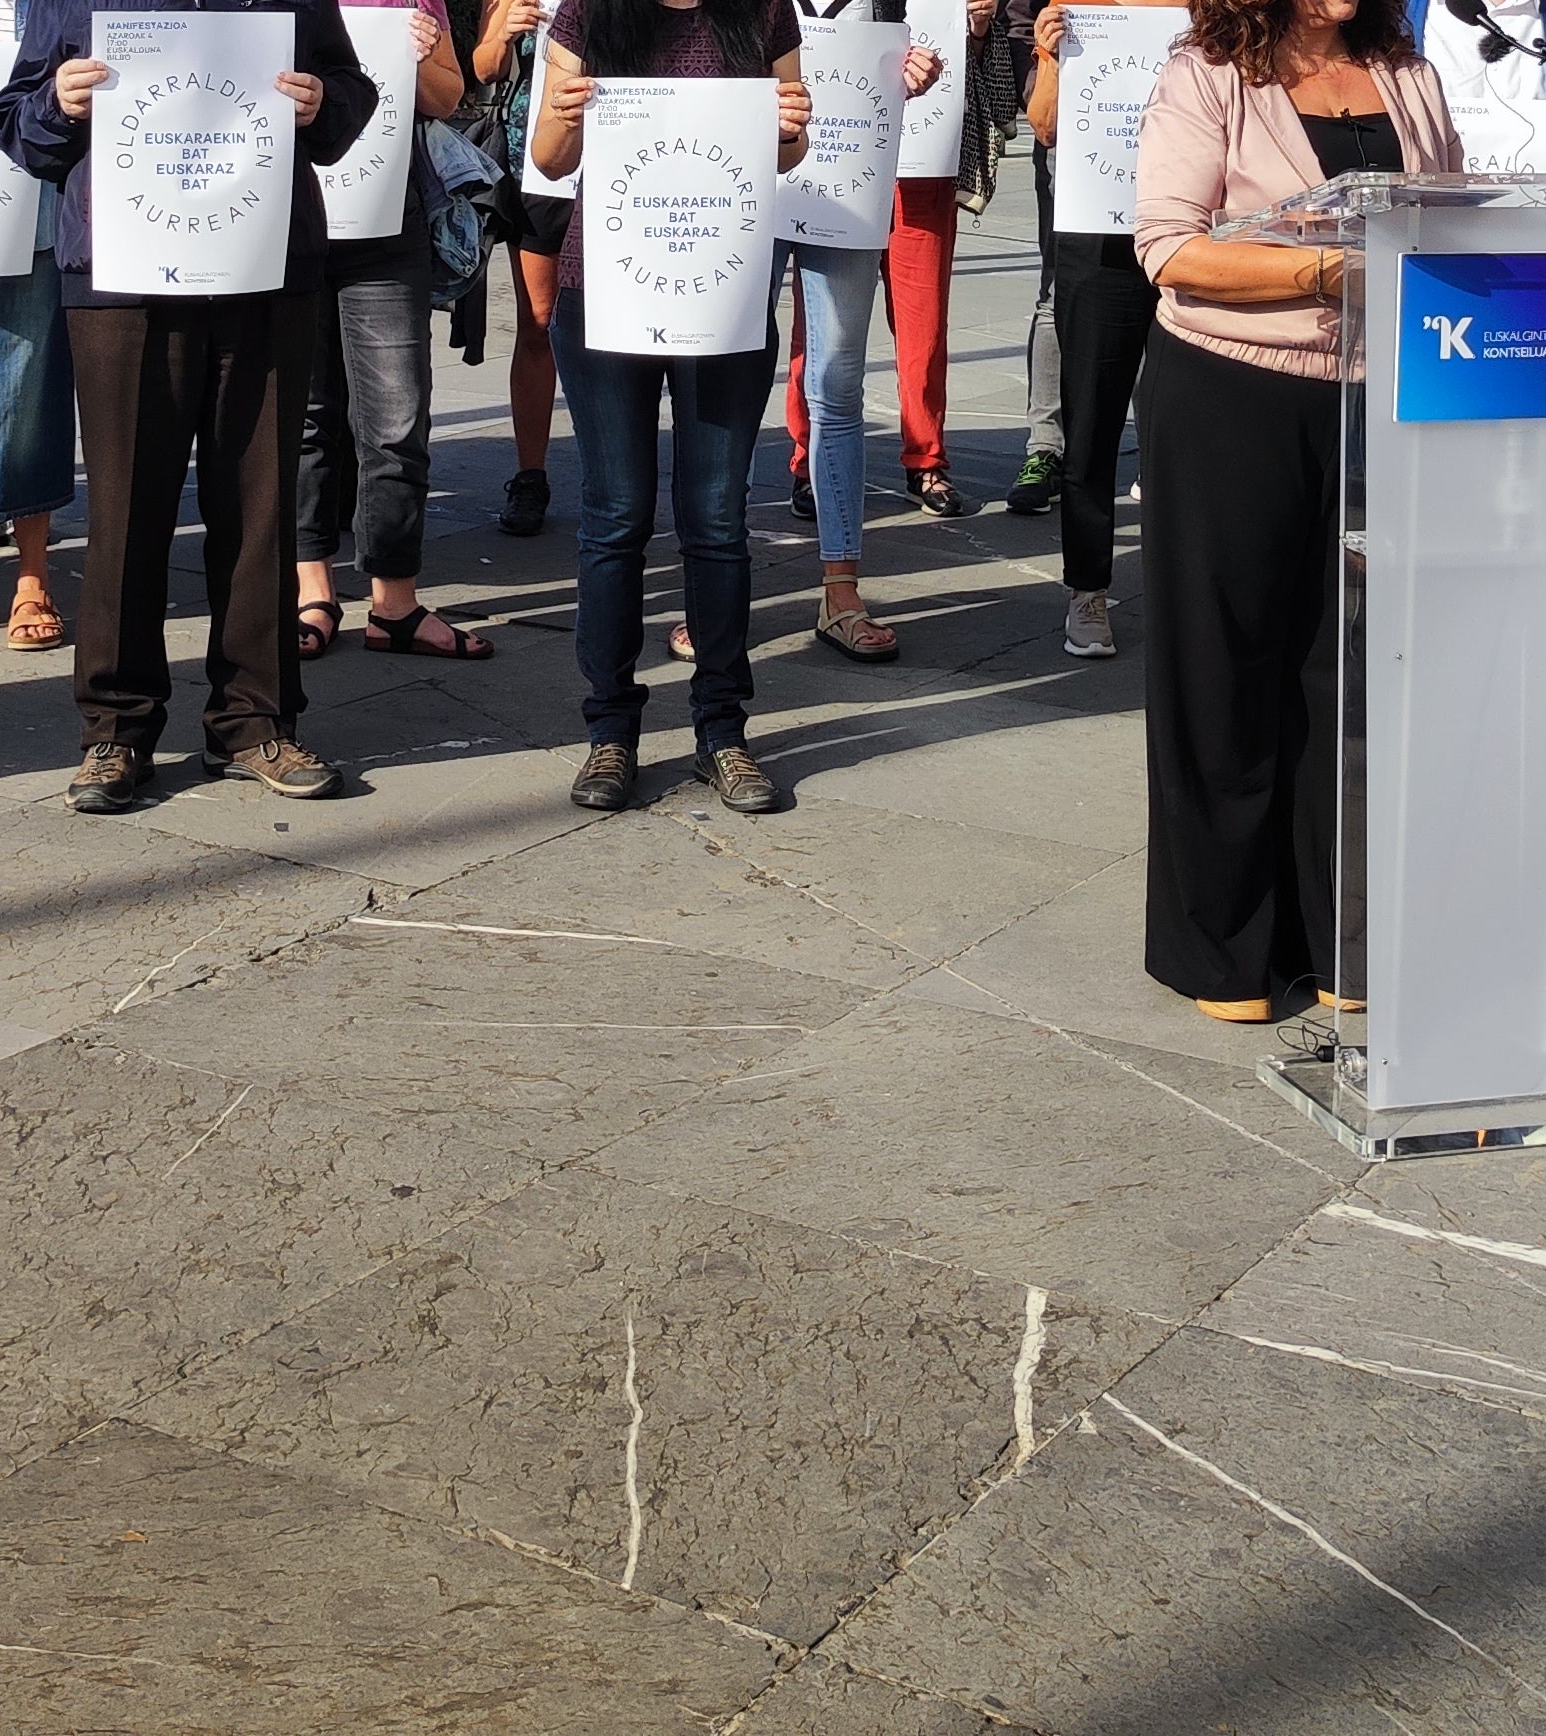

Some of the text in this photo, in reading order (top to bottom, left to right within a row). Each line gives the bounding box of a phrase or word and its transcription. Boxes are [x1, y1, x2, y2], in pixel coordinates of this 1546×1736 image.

[107, 22, 187, 31] MANIFESTAZIOA
[107, 32, 146, 40] AZAROAK
[107, 39, 128, 47] 17:00
[106, 46, 161, 54] EUSKALDUNA
[598, 87, 676, 96] MANIFESTAZIOA
[597, 98, 636, 106] AZAROAK
[116, 71, 274, 169] OLDARRALDIAREN
[808, 116, 871, 129] SKARAEKIN
[1125, 115, 1140, 125] BA
[144, 132, 246, 144] EUSKARAEKIN
[820, 129, 843, 140] BAT
[1125, 140, 1140, 149] BA
[182, 148, 209, 160] BAT
[816, 154, 840, 164] BAT
[156, 163, 235, 175] EUSKARAZ
[181, 178, 209, 190] BAT
[606, 137, 756, 233] OLDARRALDIAREN
[786, 166, 877, 198] URREAN
[633, 196, 732, 209] EUSKARAEKIN
[127, 189, 261, 234] AURREAN
[669, 211, 696, 223] BAT
[644, 226, 721, 238] EUSKARAZ
[668, 241, 695, 253] BAT
[616, 253, 744, 296] AURREAN
